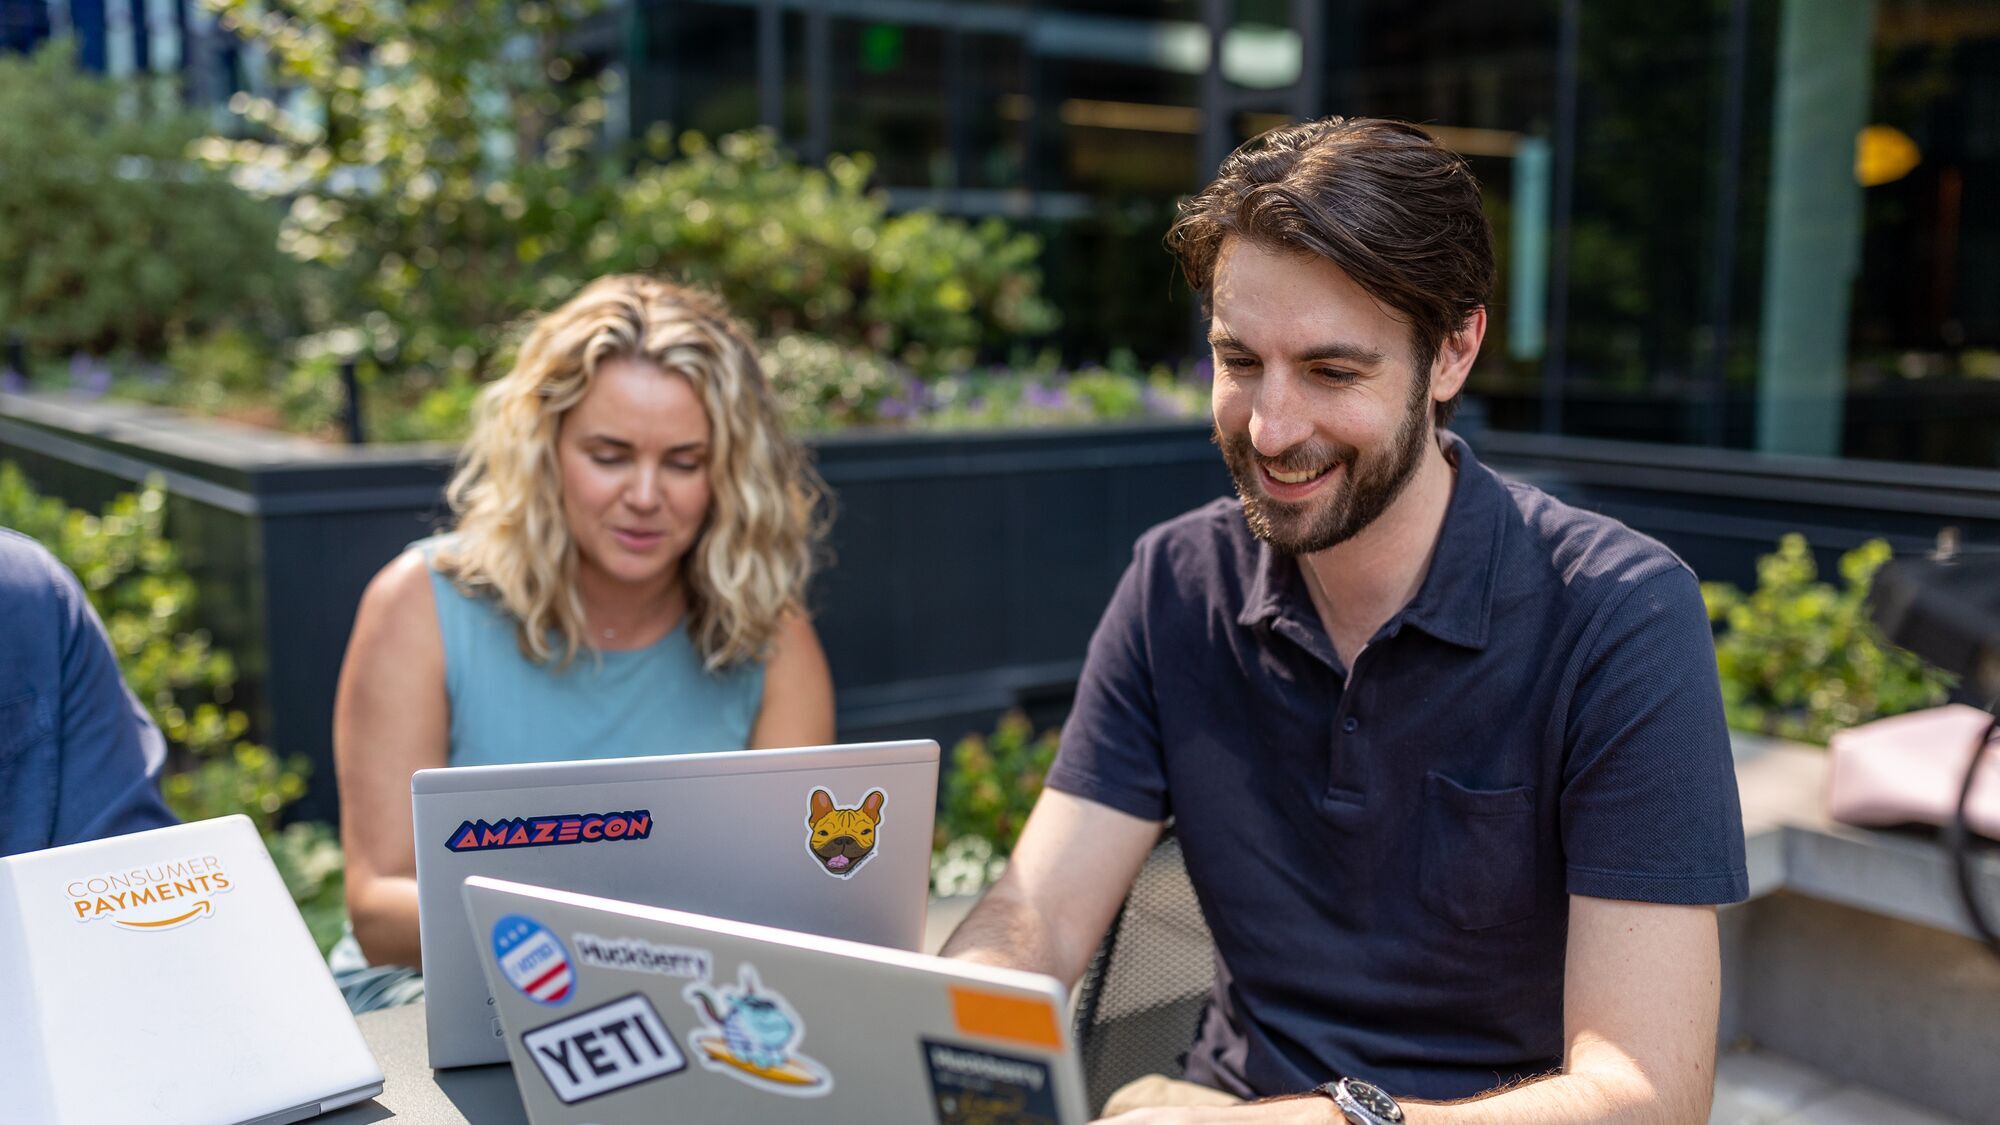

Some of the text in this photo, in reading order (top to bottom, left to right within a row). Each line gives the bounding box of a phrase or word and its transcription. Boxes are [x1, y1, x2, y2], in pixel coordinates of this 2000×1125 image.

[455, 813, 650, 849] AMAZECON
[67, 855, 221, 897] CONSUMER
[74, 872, 230, 918] PAYMENTS
[540, 1014, 663, 1085] YETI
